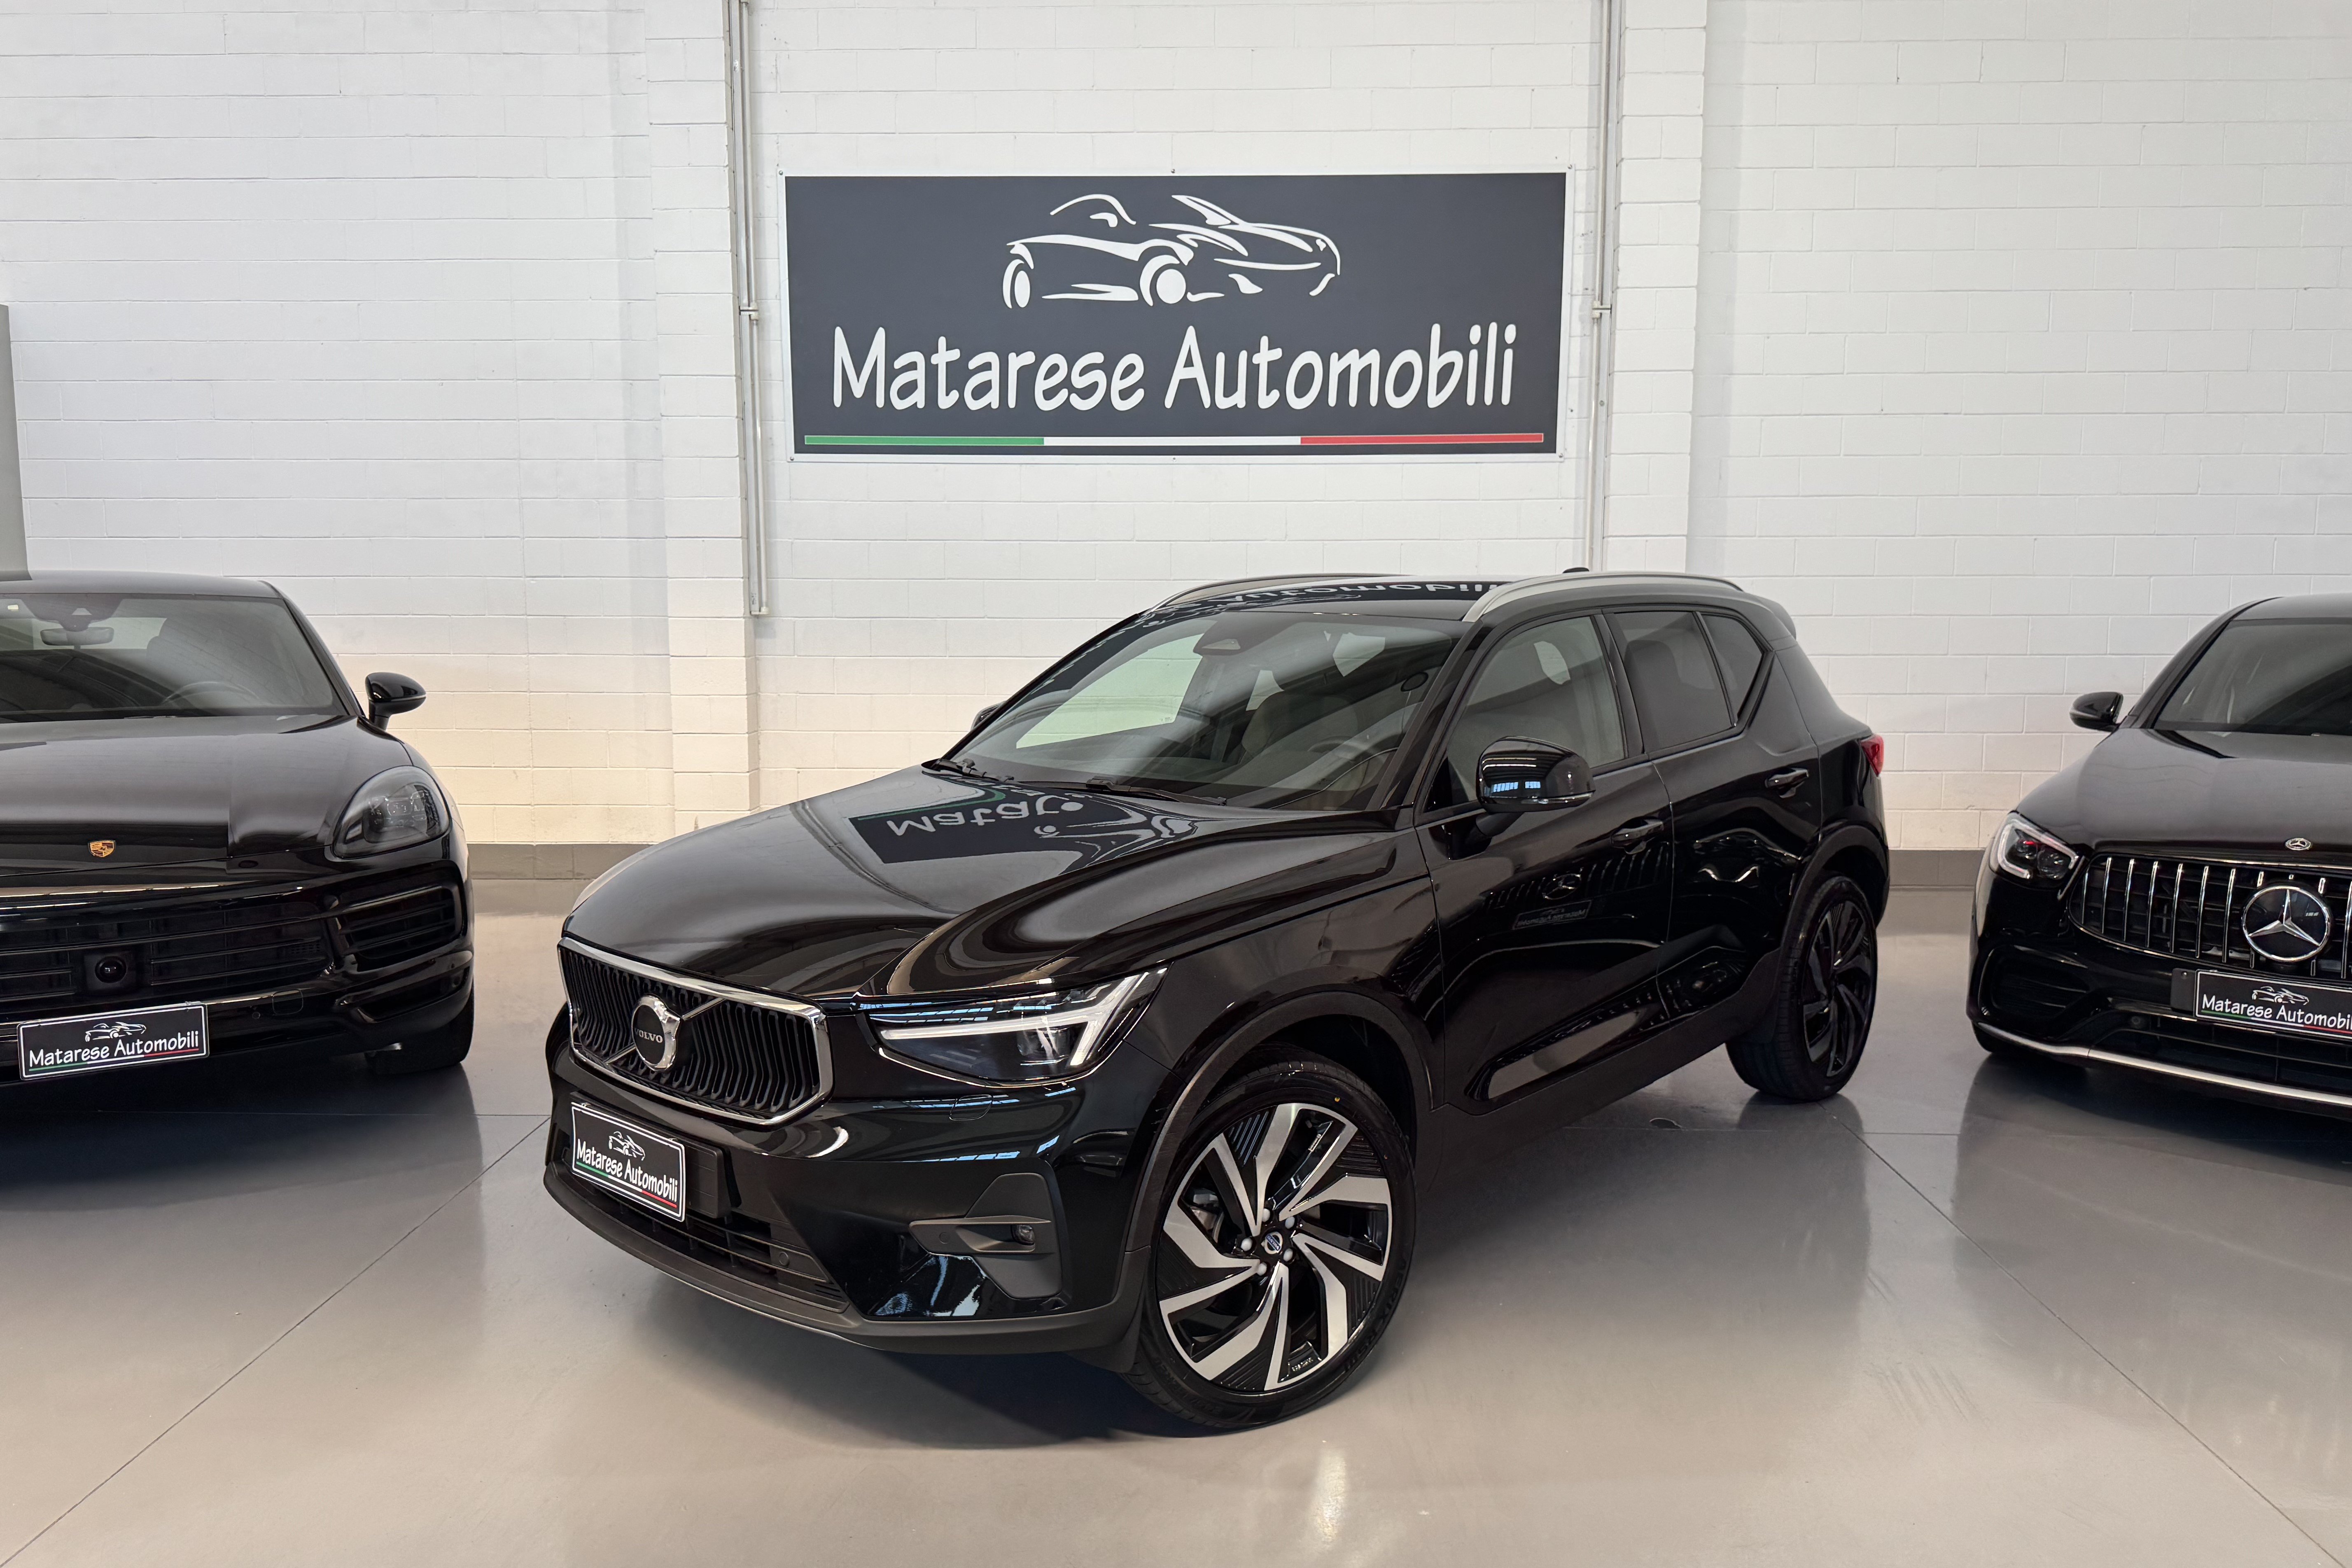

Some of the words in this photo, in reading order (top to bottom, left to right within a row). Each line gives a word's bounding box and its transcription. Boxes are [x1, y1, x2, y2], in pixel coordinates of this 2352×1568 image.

[833, 326, 1145, 411] Matarese
[1164, 322, 1516, 410] Automobili
[2202, 994, 2273, 1019] Matarese
[29, 1048, 110, 1067] Matarese
[114, 1031, 199, 1057] Automobili
[635, 1028, 663, 1043] VOLVO
[576, 1139, 623, 1178] Matarese
[624, 1159, 678, 1202] Automobili
